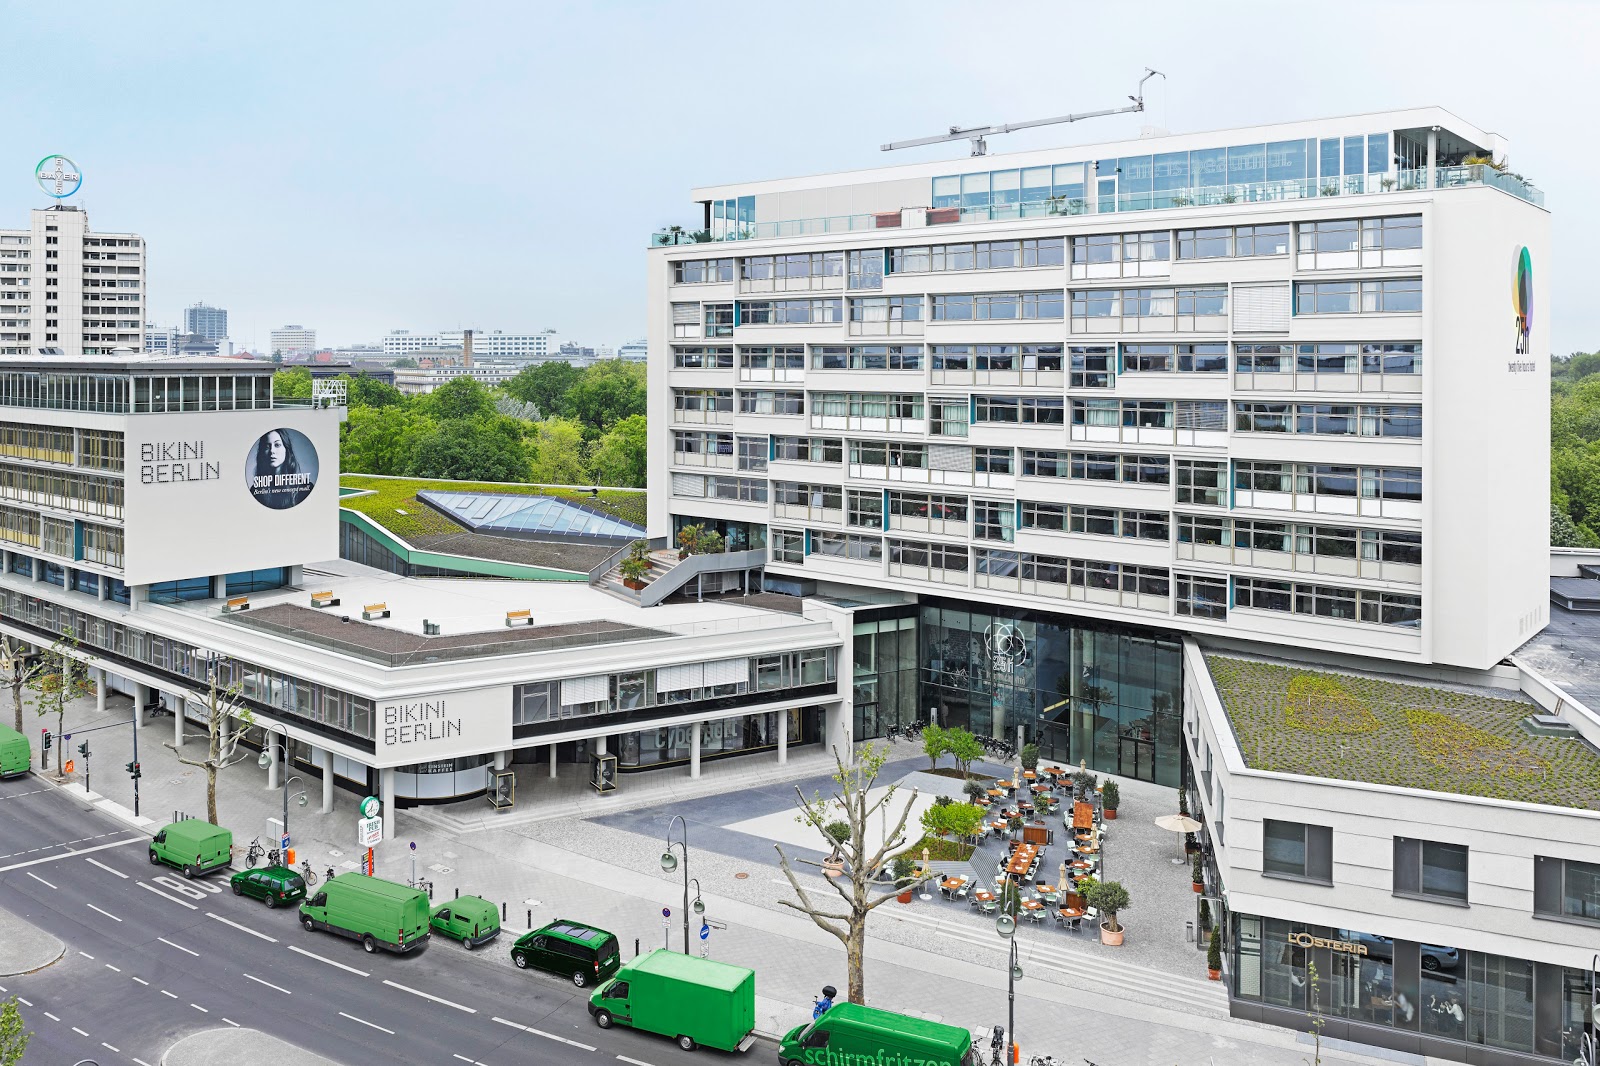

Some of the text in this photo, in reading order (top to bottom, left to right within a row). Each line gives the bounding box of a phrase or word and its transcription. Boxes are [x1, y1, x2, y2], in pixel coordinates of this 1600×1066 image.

[40, 172, 78, 181] BAYER
[55, 158, 63, 194] BAYER
[1516, 316, 1529, 354] 25h
[141, 441, 203, 462] BIKINI
[141, 461, 219, 484] BERLIN
[253, 475, 273, 488] SHOP
[385, 700, 445, 724] BIKINI
[385, 718, 461, 746] BERLIN
[655, 719, 738, 750] Cybeport
[805, 1045, 952, 1066] schirmfrit
